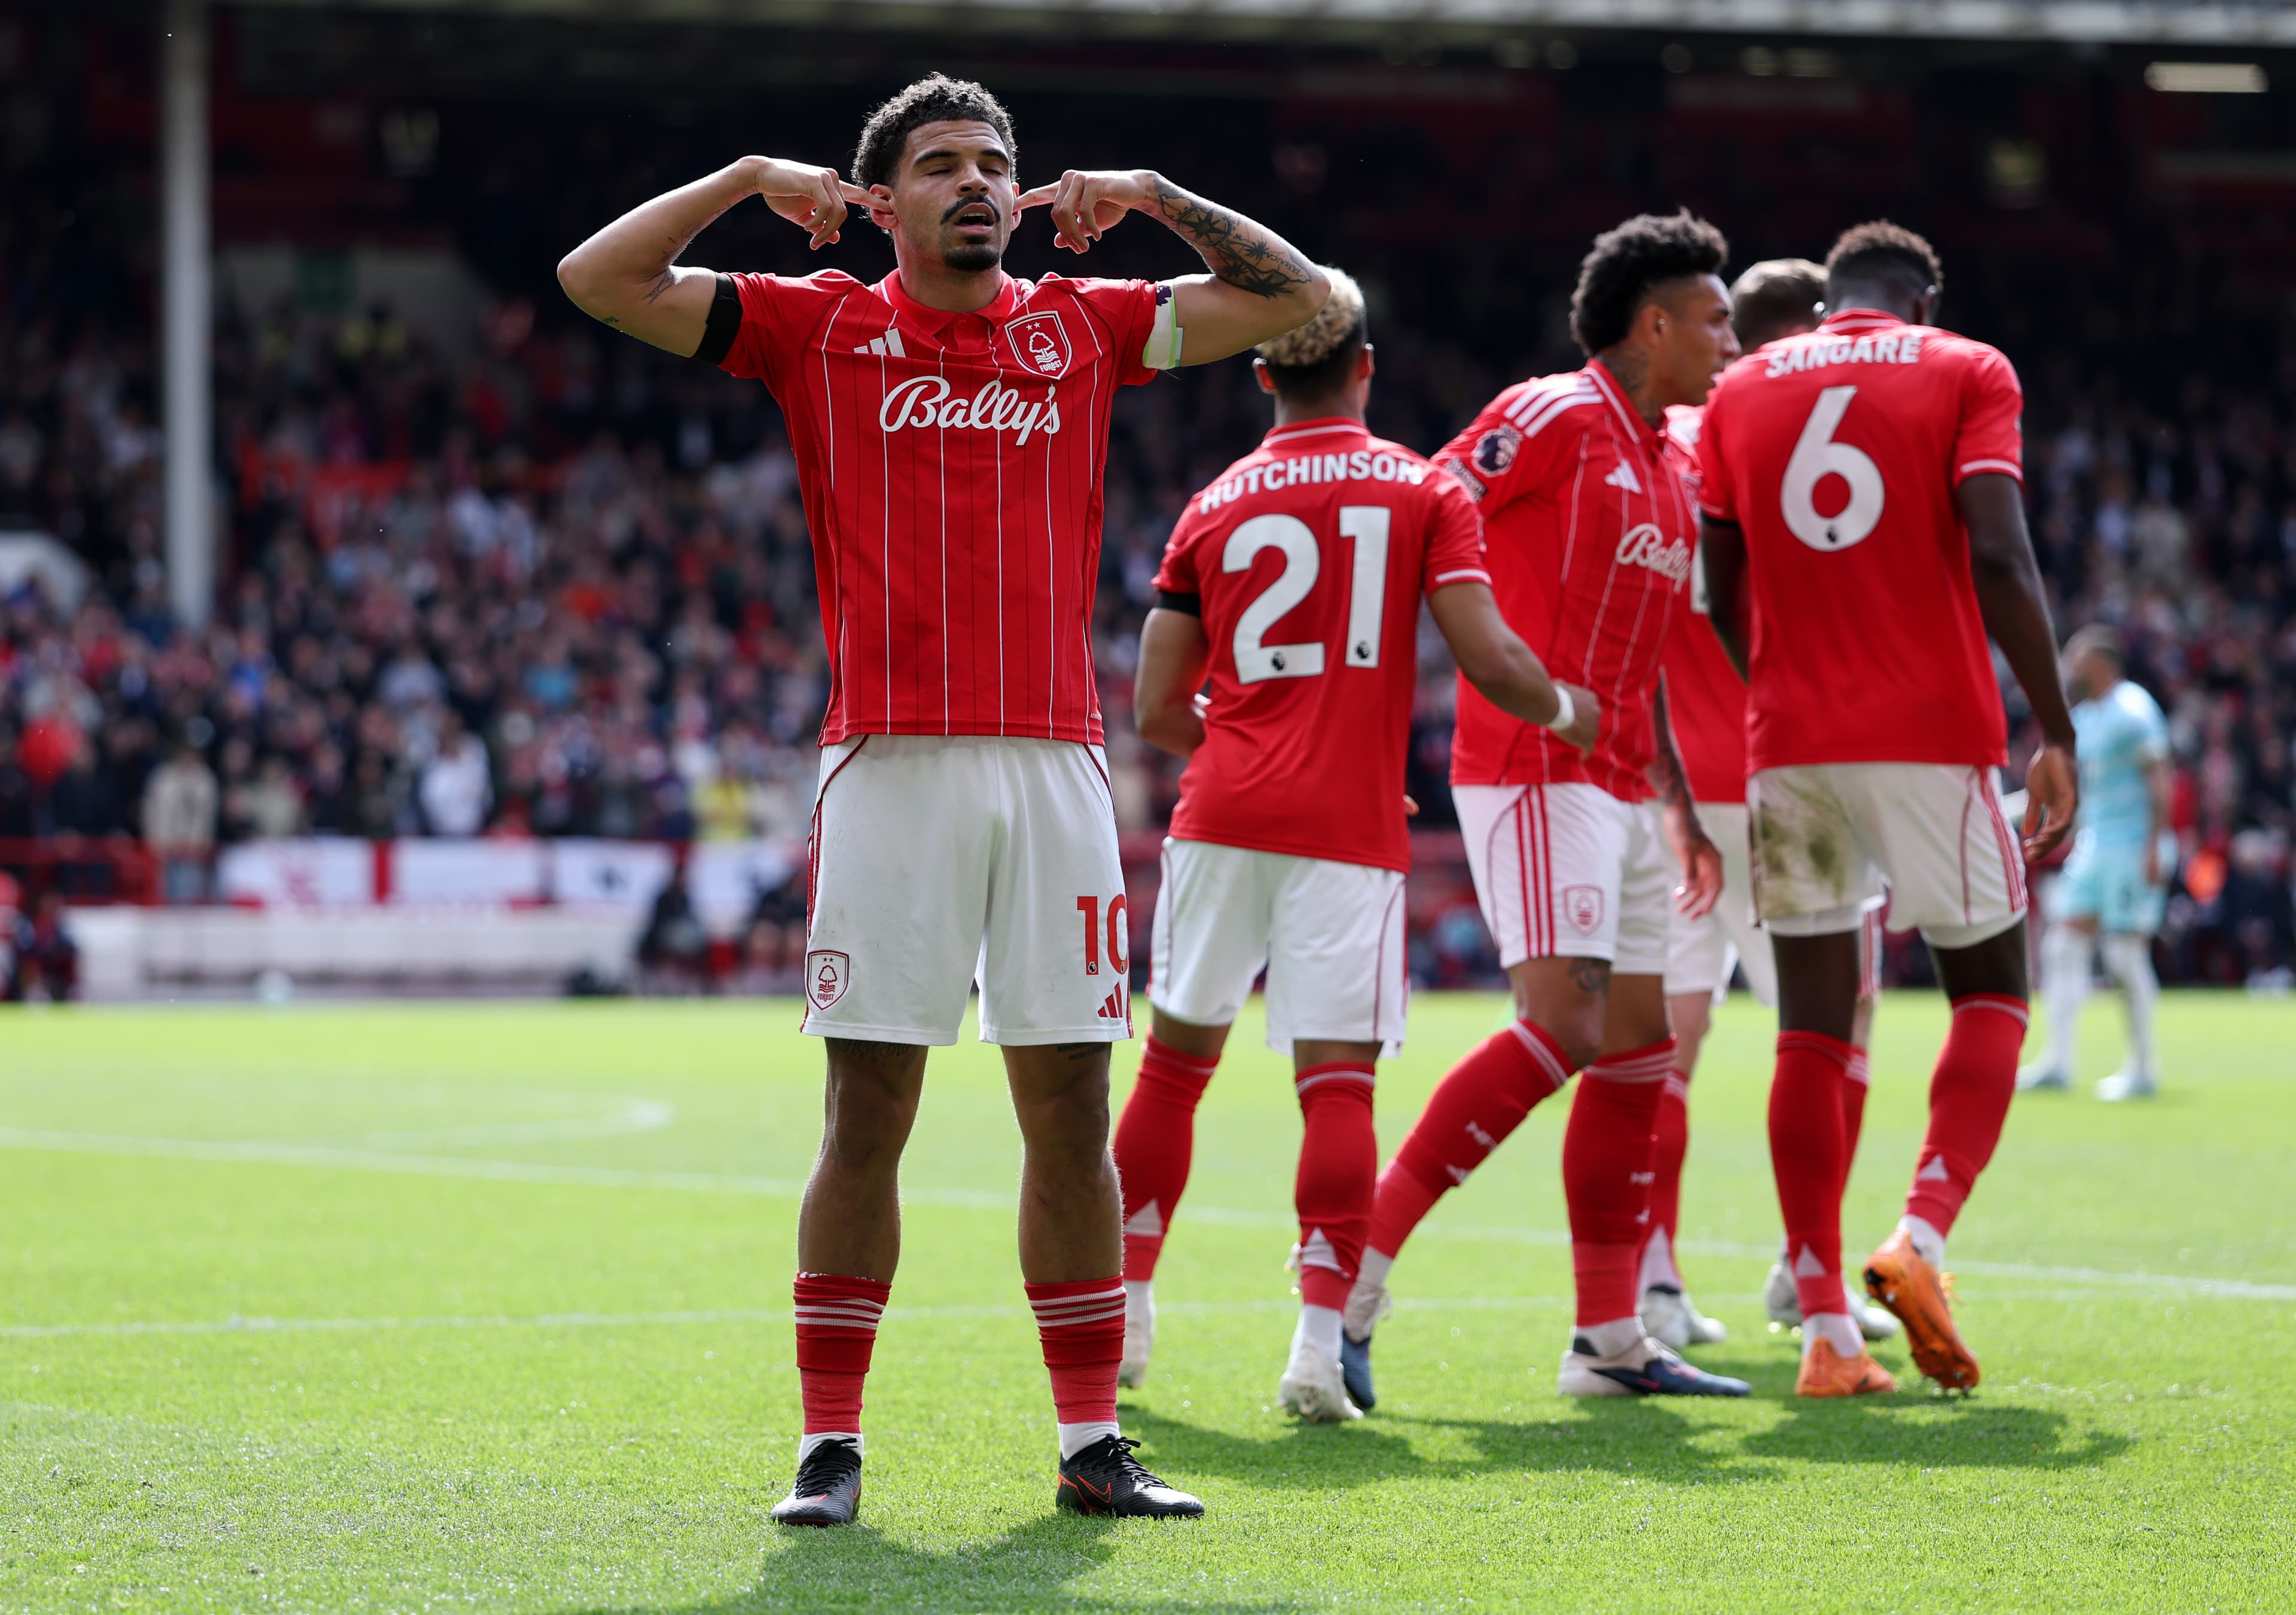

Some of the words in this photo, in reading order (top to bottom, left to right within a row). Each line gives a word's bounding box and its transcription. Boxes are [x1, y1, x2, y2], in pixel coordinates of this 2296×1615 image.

[880, 375, 1061, 446] Bally's
[1199, 450, 1424, 515] HUTCHINSON
[1779, 384, 1885, 552] 6
[1222, 505, 1391, 685] 21
[1077, 893, 1129, 975] 10
